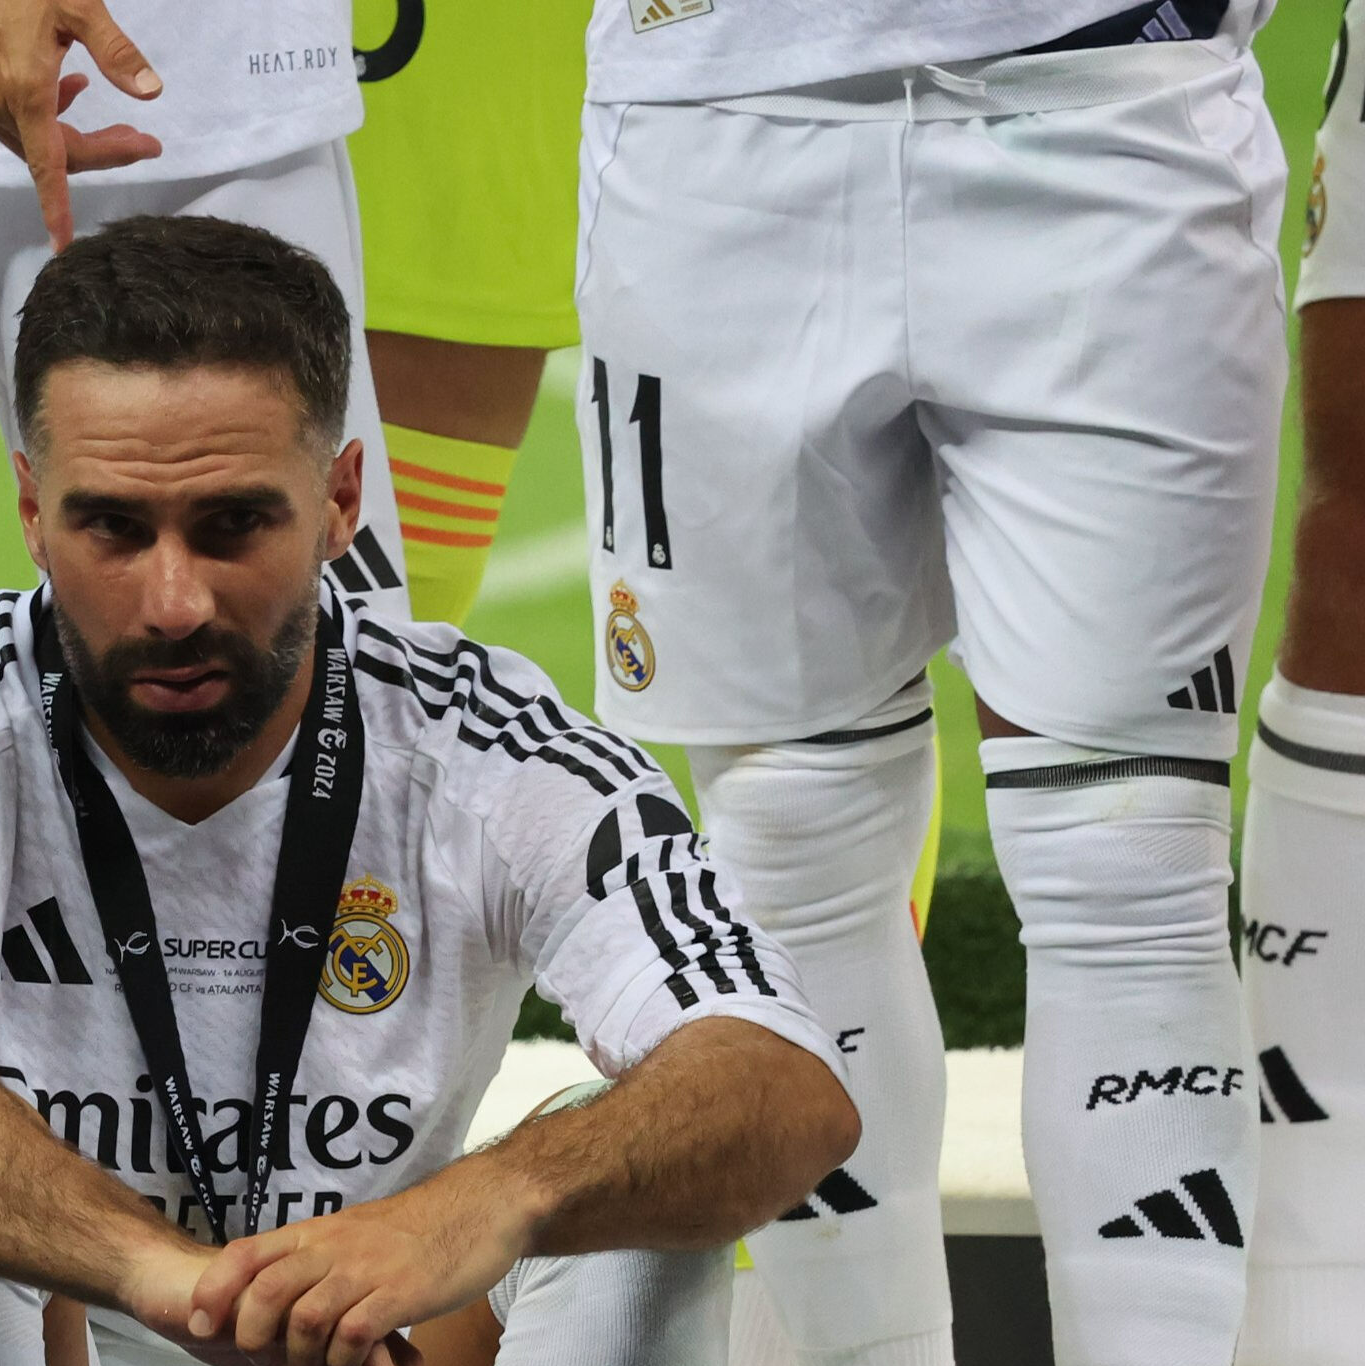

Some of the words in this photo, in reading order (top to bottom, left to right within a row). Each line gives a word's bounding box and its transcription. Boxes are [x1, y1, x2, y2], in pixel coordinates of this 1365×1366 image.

[249, 47, 338, 75] HEAT.RDY
[591, 356, 673, 571] 11
[322, 648, 347, 724] WARSAW
[312, 753, 337, 799] 2024
[164, 938, 236, 960] SUPER
[238, 940, 270, 960] CU
[207, 984, 262, 995] ATALANTA
[165, 1075, 194, 1150] WARSAW
[260, 1072, 281, 1149] WARSAW
